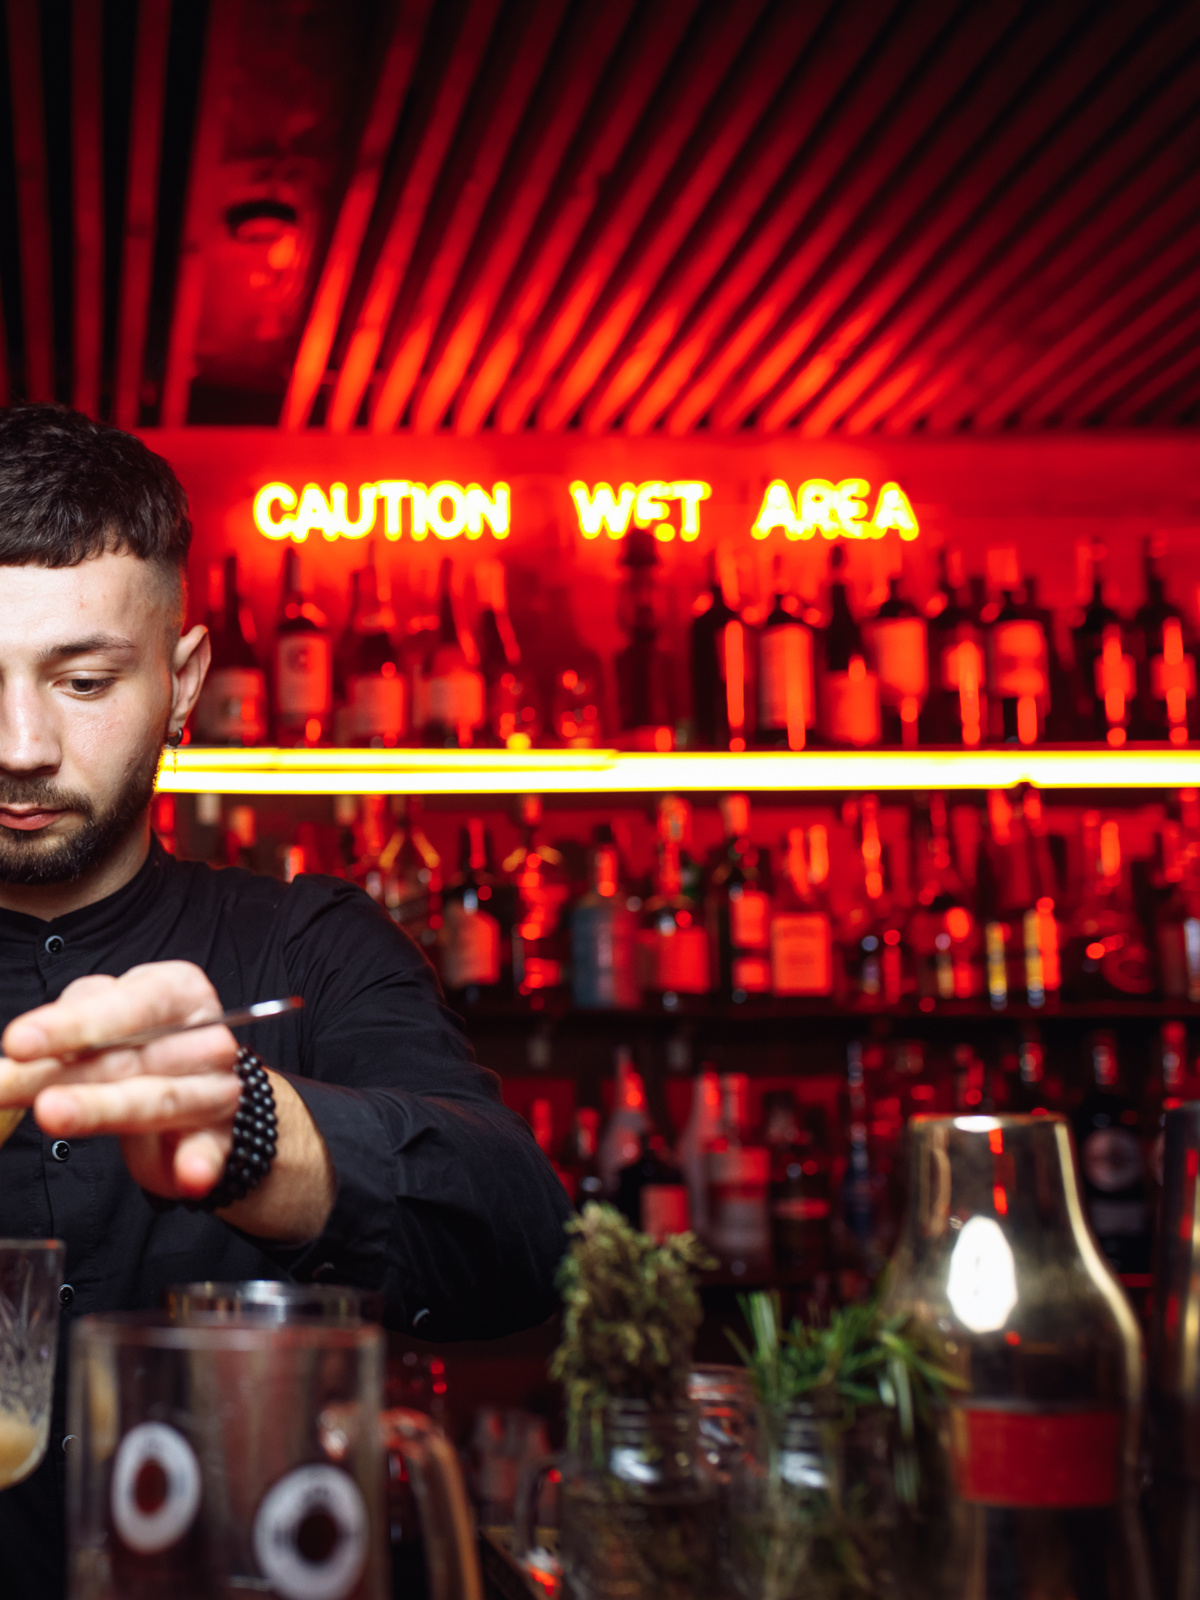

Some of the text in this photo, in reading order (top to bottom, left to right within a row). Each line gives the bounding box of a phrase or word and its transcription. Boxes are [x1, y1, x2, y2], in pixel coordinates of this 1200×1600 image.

[253, 478, 919, 543] CAUTION WET AREA
